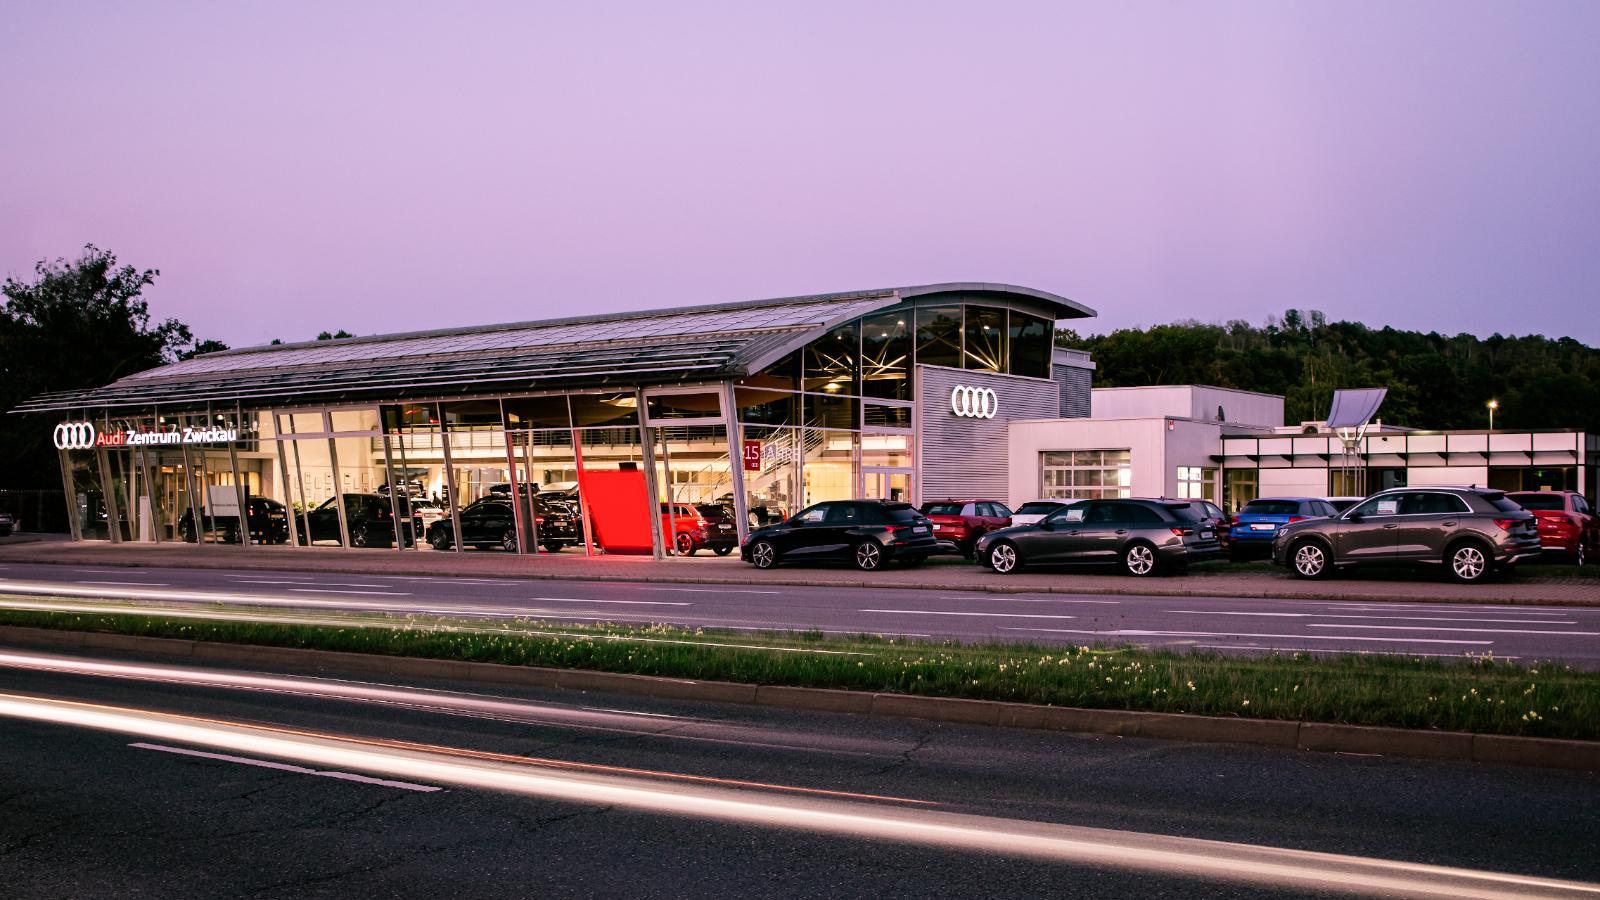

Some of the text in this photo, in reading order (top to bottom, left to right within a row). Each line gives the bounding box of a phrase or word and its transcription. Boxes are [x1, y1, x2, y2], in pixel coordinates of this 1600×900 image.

[97, 427, 236, 445] Audi Zentrum Zwickau
[745, 445, 759, 460] 15
